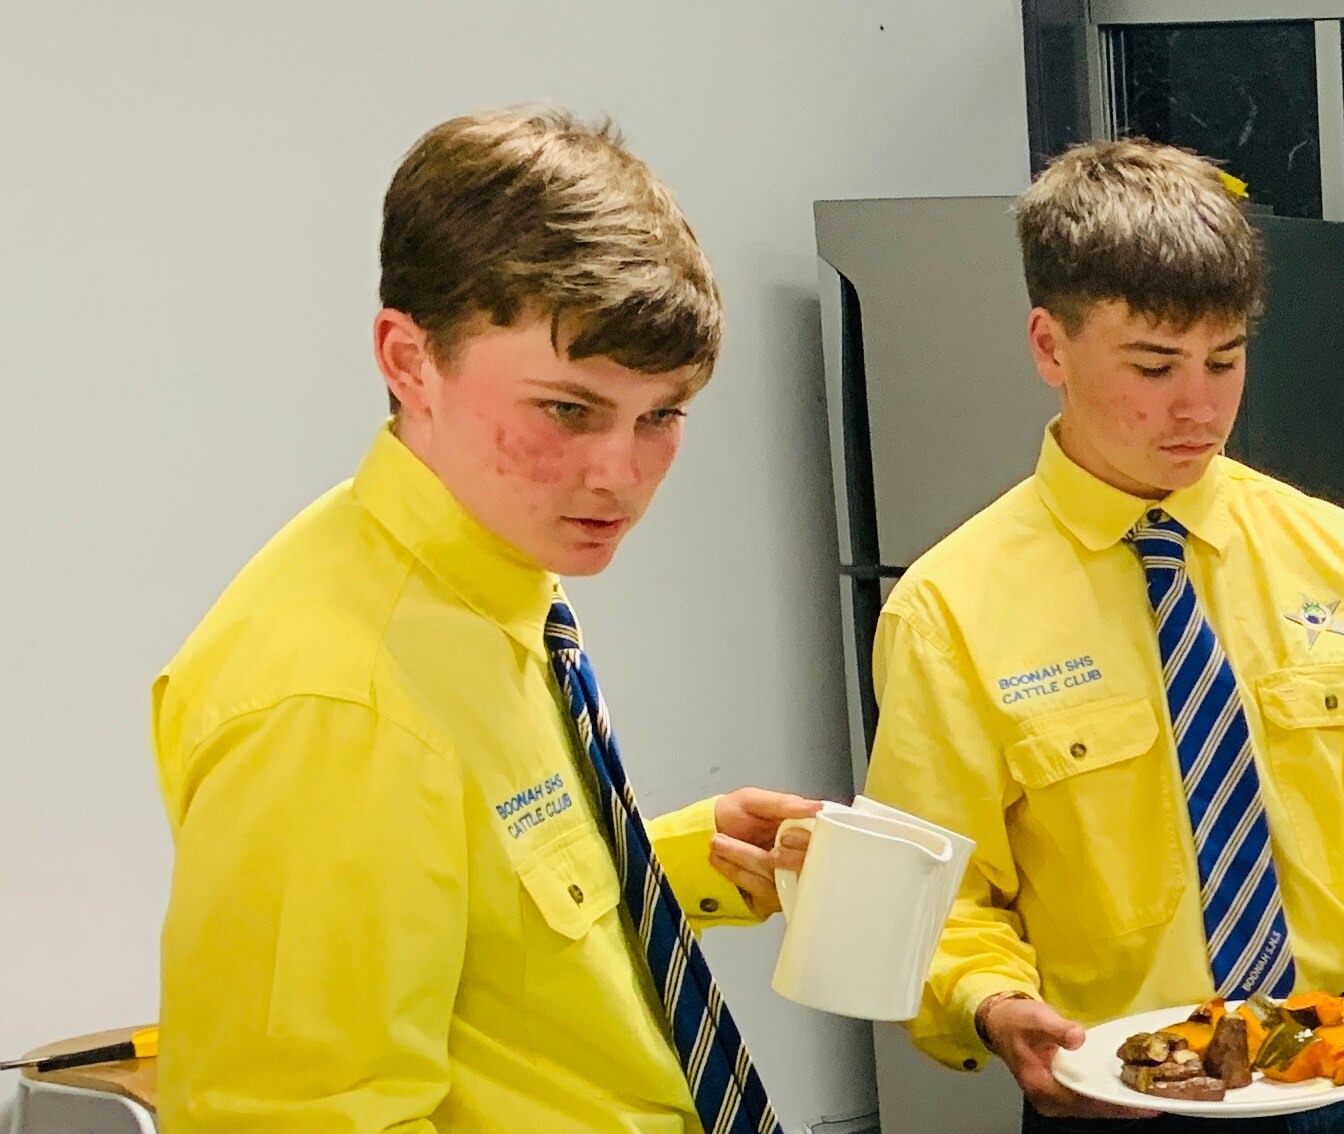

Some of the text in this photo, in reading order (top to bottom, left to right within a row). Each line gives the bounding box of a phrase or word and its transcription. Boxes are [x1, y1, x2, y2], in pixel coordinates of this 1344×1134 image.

[998, 655, 1094, 689] BOONAH SHS
[1002, 669, 1102, 704] CATTLE CLUB
[496, 773, 564, 820] BOONAH SHS
[508, 793, 572, 839] CATTLE CLUB
